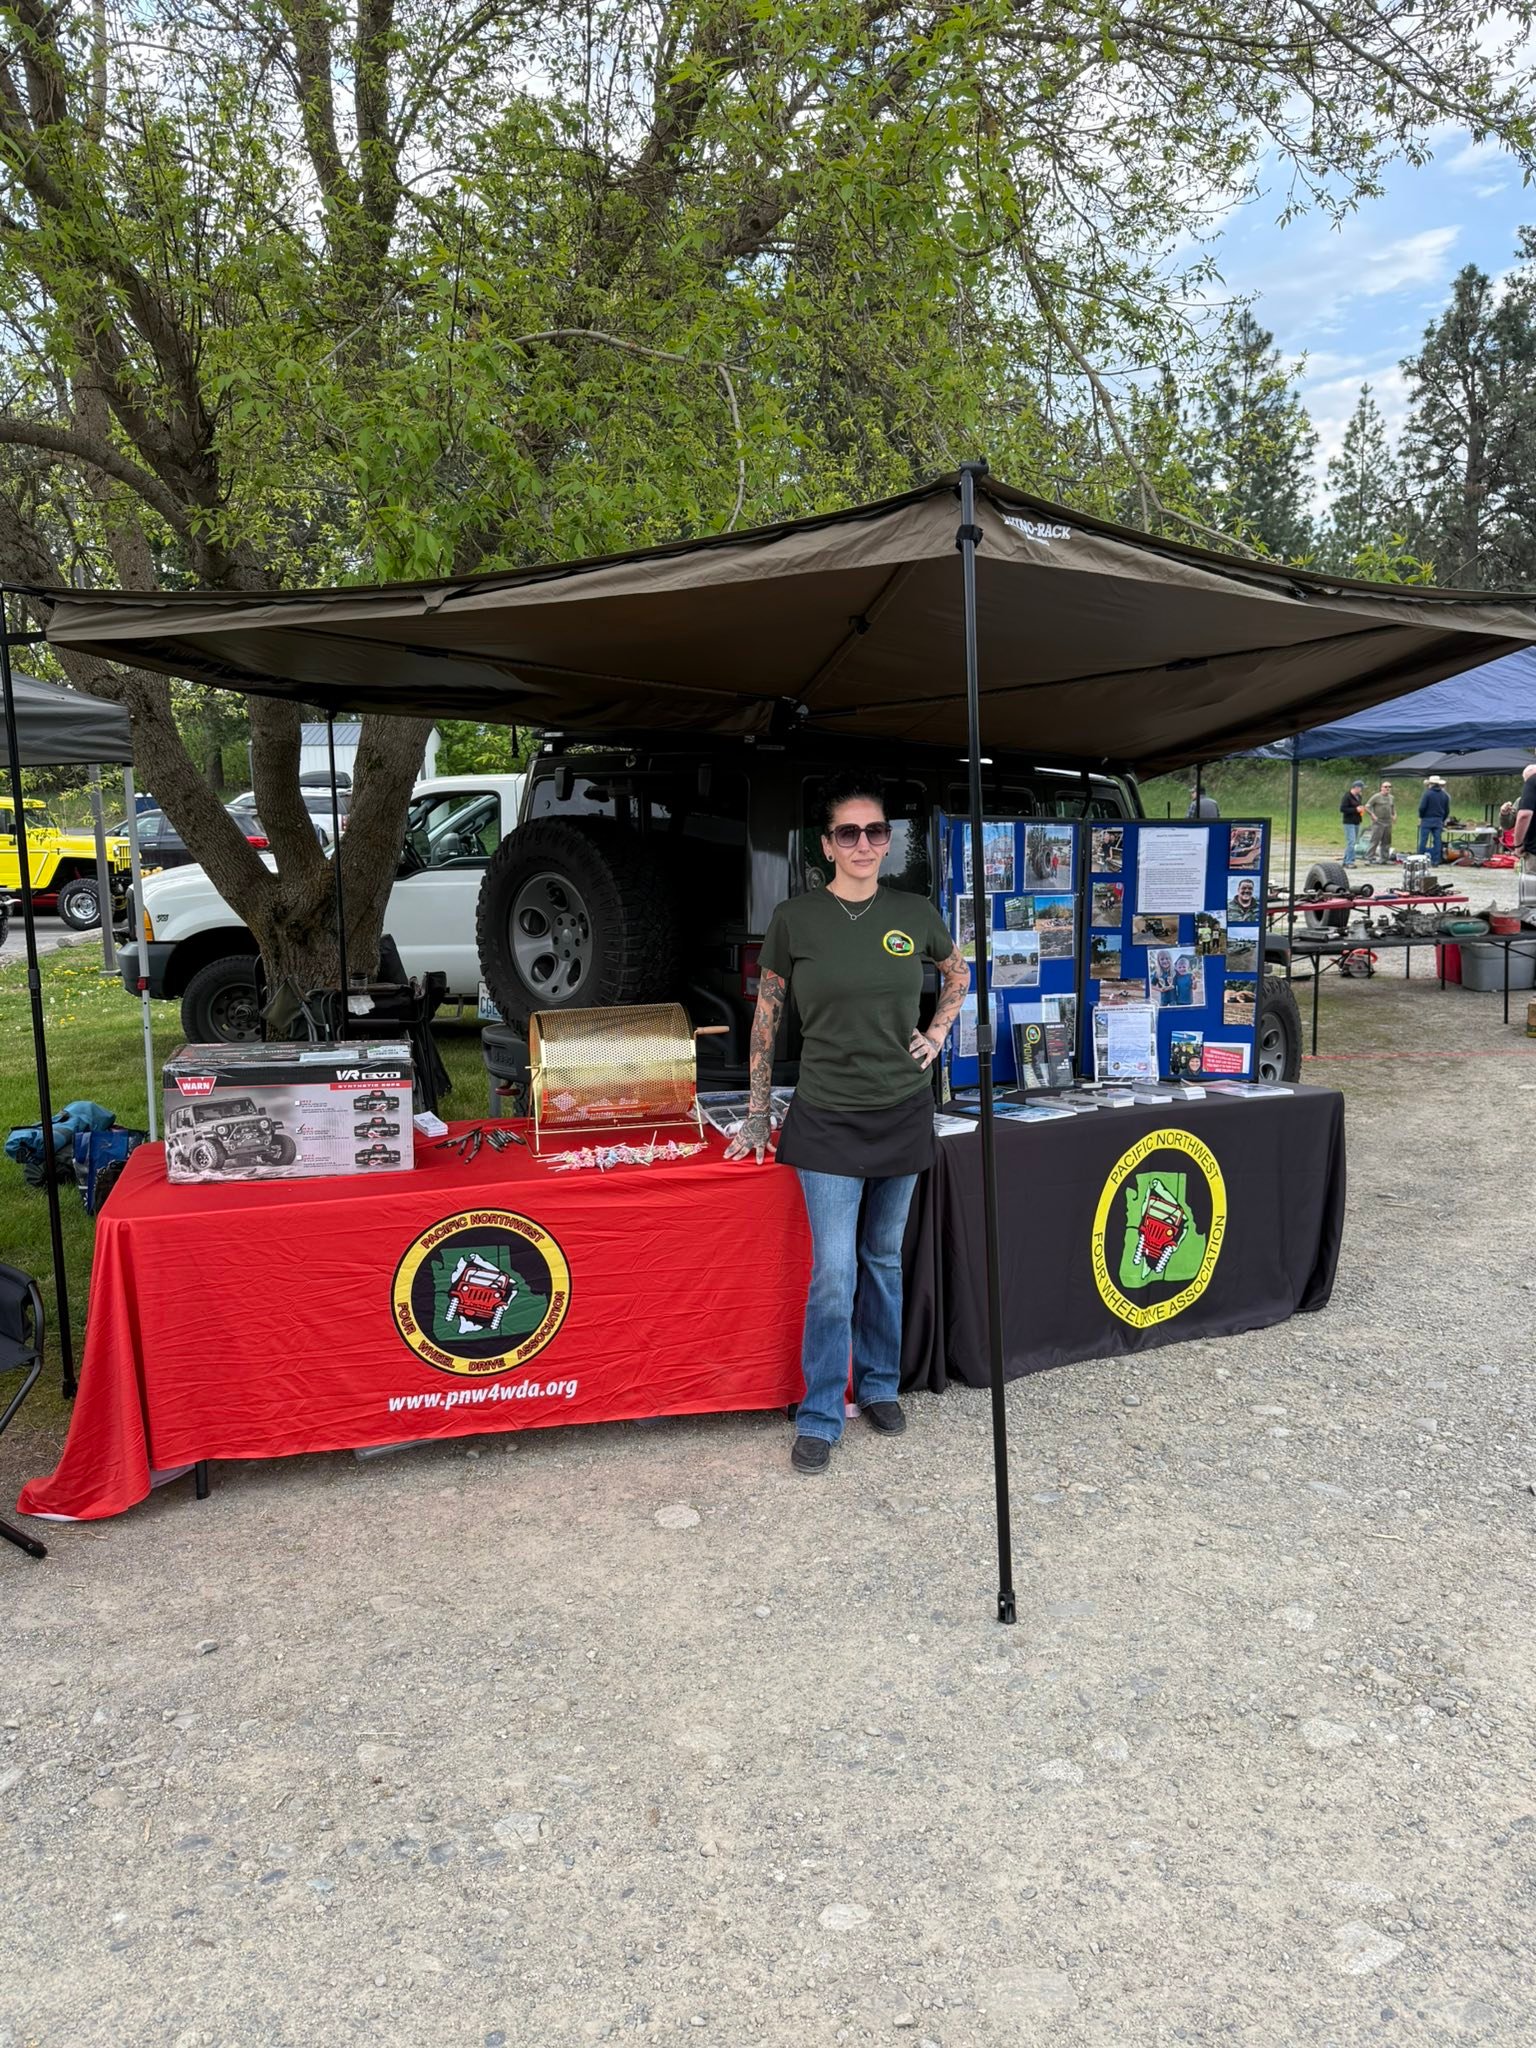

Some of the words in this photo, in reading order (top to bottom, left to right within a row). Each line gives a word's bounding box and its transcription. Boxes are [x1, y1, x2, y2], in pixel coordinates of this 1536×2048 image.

[181, 1082, 210, 1091] WARN
[335, 1069, 360, 1081] VR
[363, 1072, 399, 1080] EVO
[1110, 1136, 1154, 1185] PACIFIC
[1156, 1132, 1220, 1180] NORTHWEST
[420, 1216, 469, 1249] PACIFIC
[470, 1213, 546, 1242] NORTHWEST
[1094, 1231, 1106, 1284] FOUR
[1103, 1279, 1140, 1327] WHEEL
[1169, 1215, 1226, 1315] ASSOCIATION
[397, 1301, 416, 1336] FOUR
[418, 1339, 455, 1369] WHEEL
[468, 1358, 506, 1372] DRIVE
[517, 1291, 566, 1360] ASSOCIATION
[388, 1379, 578, 1412] www.pnw4wda.org
